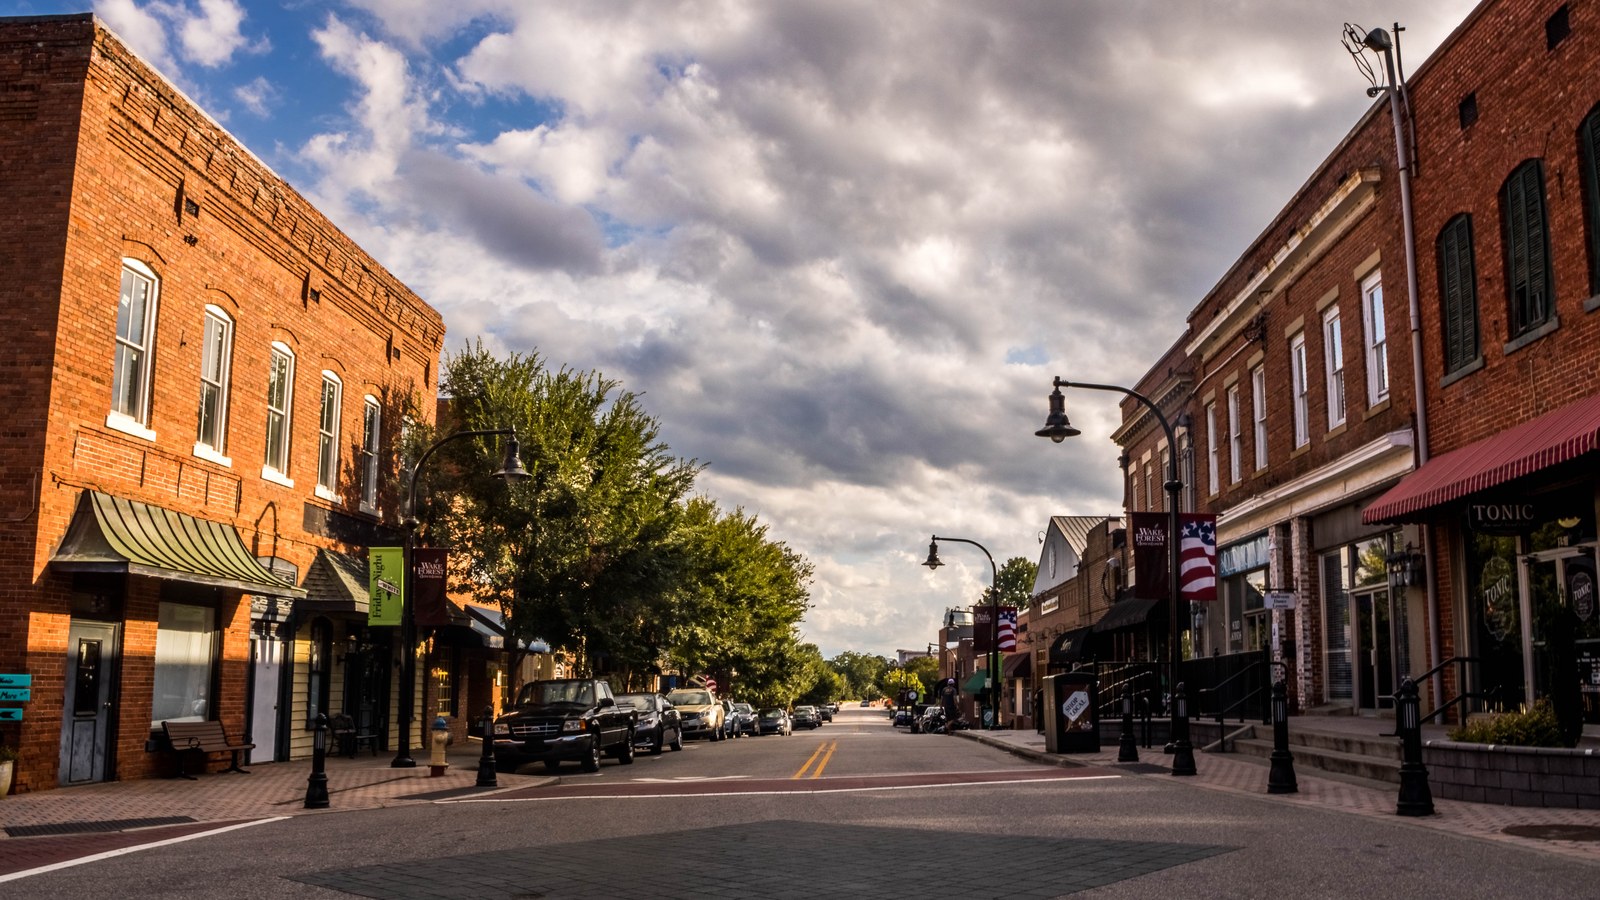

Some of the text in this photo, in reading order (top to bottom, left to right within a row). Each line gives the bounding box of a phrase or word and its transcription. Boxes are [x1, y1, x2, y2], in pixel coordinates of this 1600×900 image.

[1473, 504, 1534, 521] TONIC
[1135, 534, 1165, 542] FOREST
[1139, 528, 1163, 536] WAKE
[373, 555, 385, 580] Night
[417, 567, 445, 575] FOREST
[421, 562, 443, 570] WAKE
[1484, 574, 1510, 606] TONIC
[1573, 582, 1591, 601] TONIC
[373, 588, 384, 618] Friday
[1065, 697, 1079, 713] SHOP
[1069, 699, 1087, 716] LOCAL
